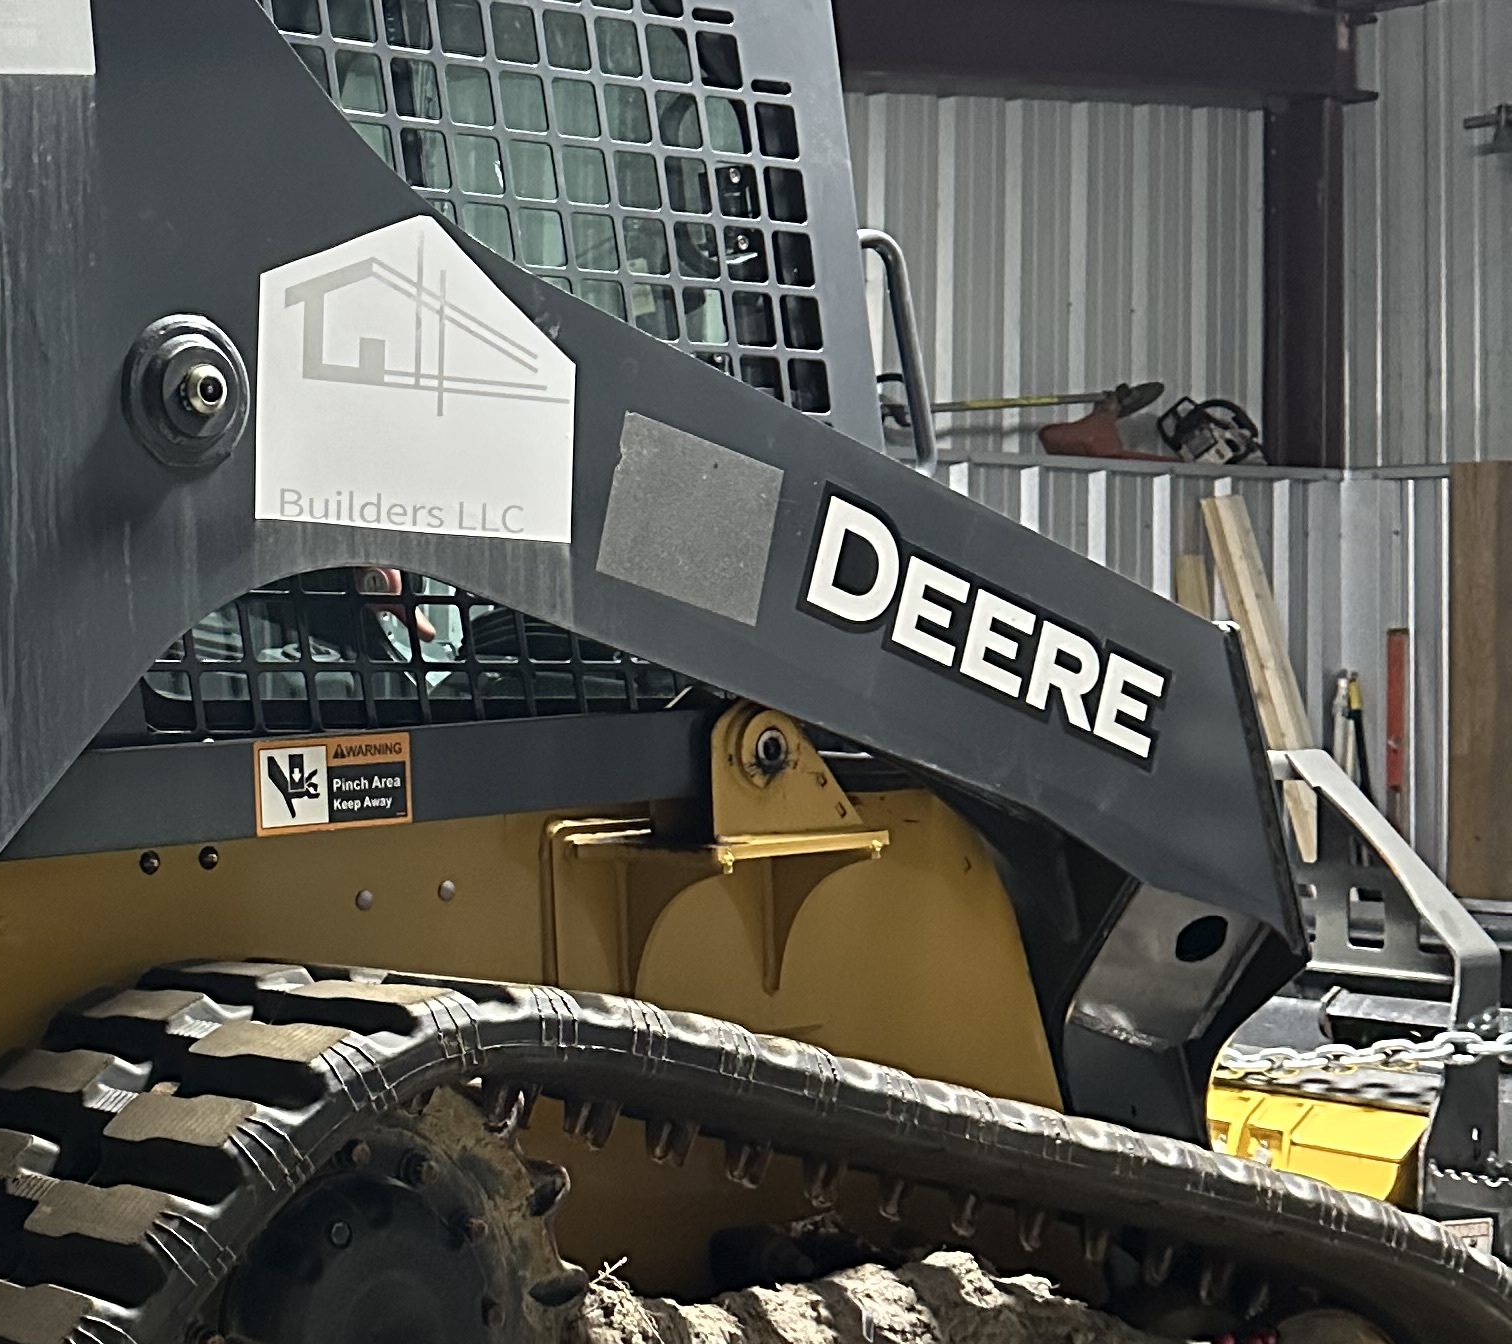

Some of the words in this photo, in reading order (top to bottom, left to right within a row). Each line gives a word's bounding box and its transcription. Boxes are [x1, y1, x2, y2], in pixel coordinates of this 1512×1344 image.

[278, 487, 445, 529] Builders
[458, 500, 526, 535] LLC
[806, 494, 1165, 759] DEERE
[344, 741, 403, 757] WARNING
[332, 776, 369, 793] Pinch
[371, 775, 401, 789] Area
[333, 798, 361, 812] Keep
[363, 796, 393, 809] Away
